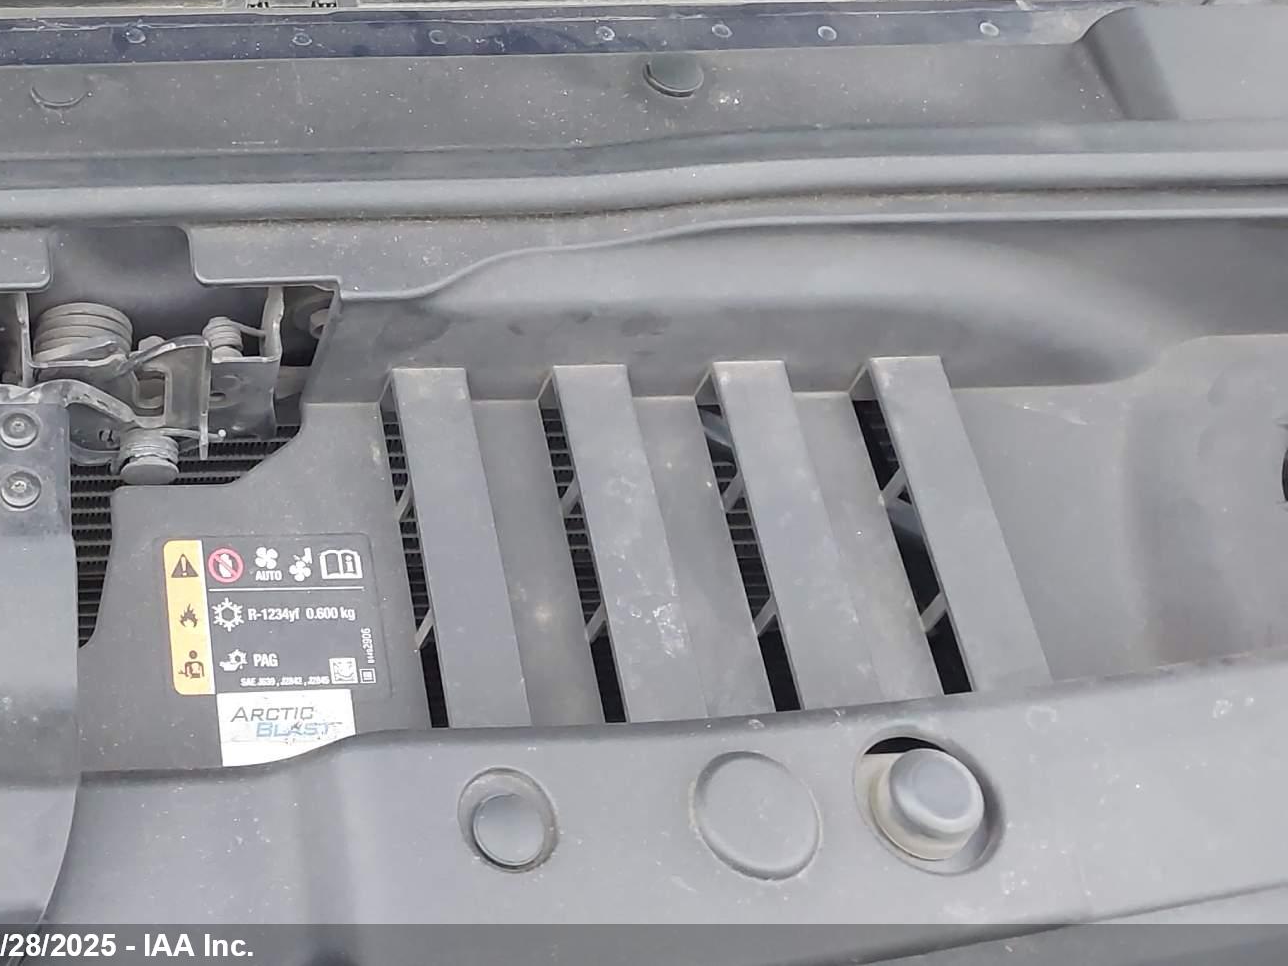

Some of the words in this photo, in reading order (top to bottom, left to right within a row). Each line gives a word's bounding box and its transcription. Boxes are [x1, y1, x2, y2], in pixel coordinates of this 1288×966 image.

[255, 570, 282, 581] AUTO
[248, 607, 300, 622] R-1234yf
[305, 607, 339, 620] 0.600
[340, 606, 356, 621] kg
[253, 653, 279, 667] PAG
[231, 706, 314, 722] ARCTIC
[256, 721, 329, 737] BLAST
